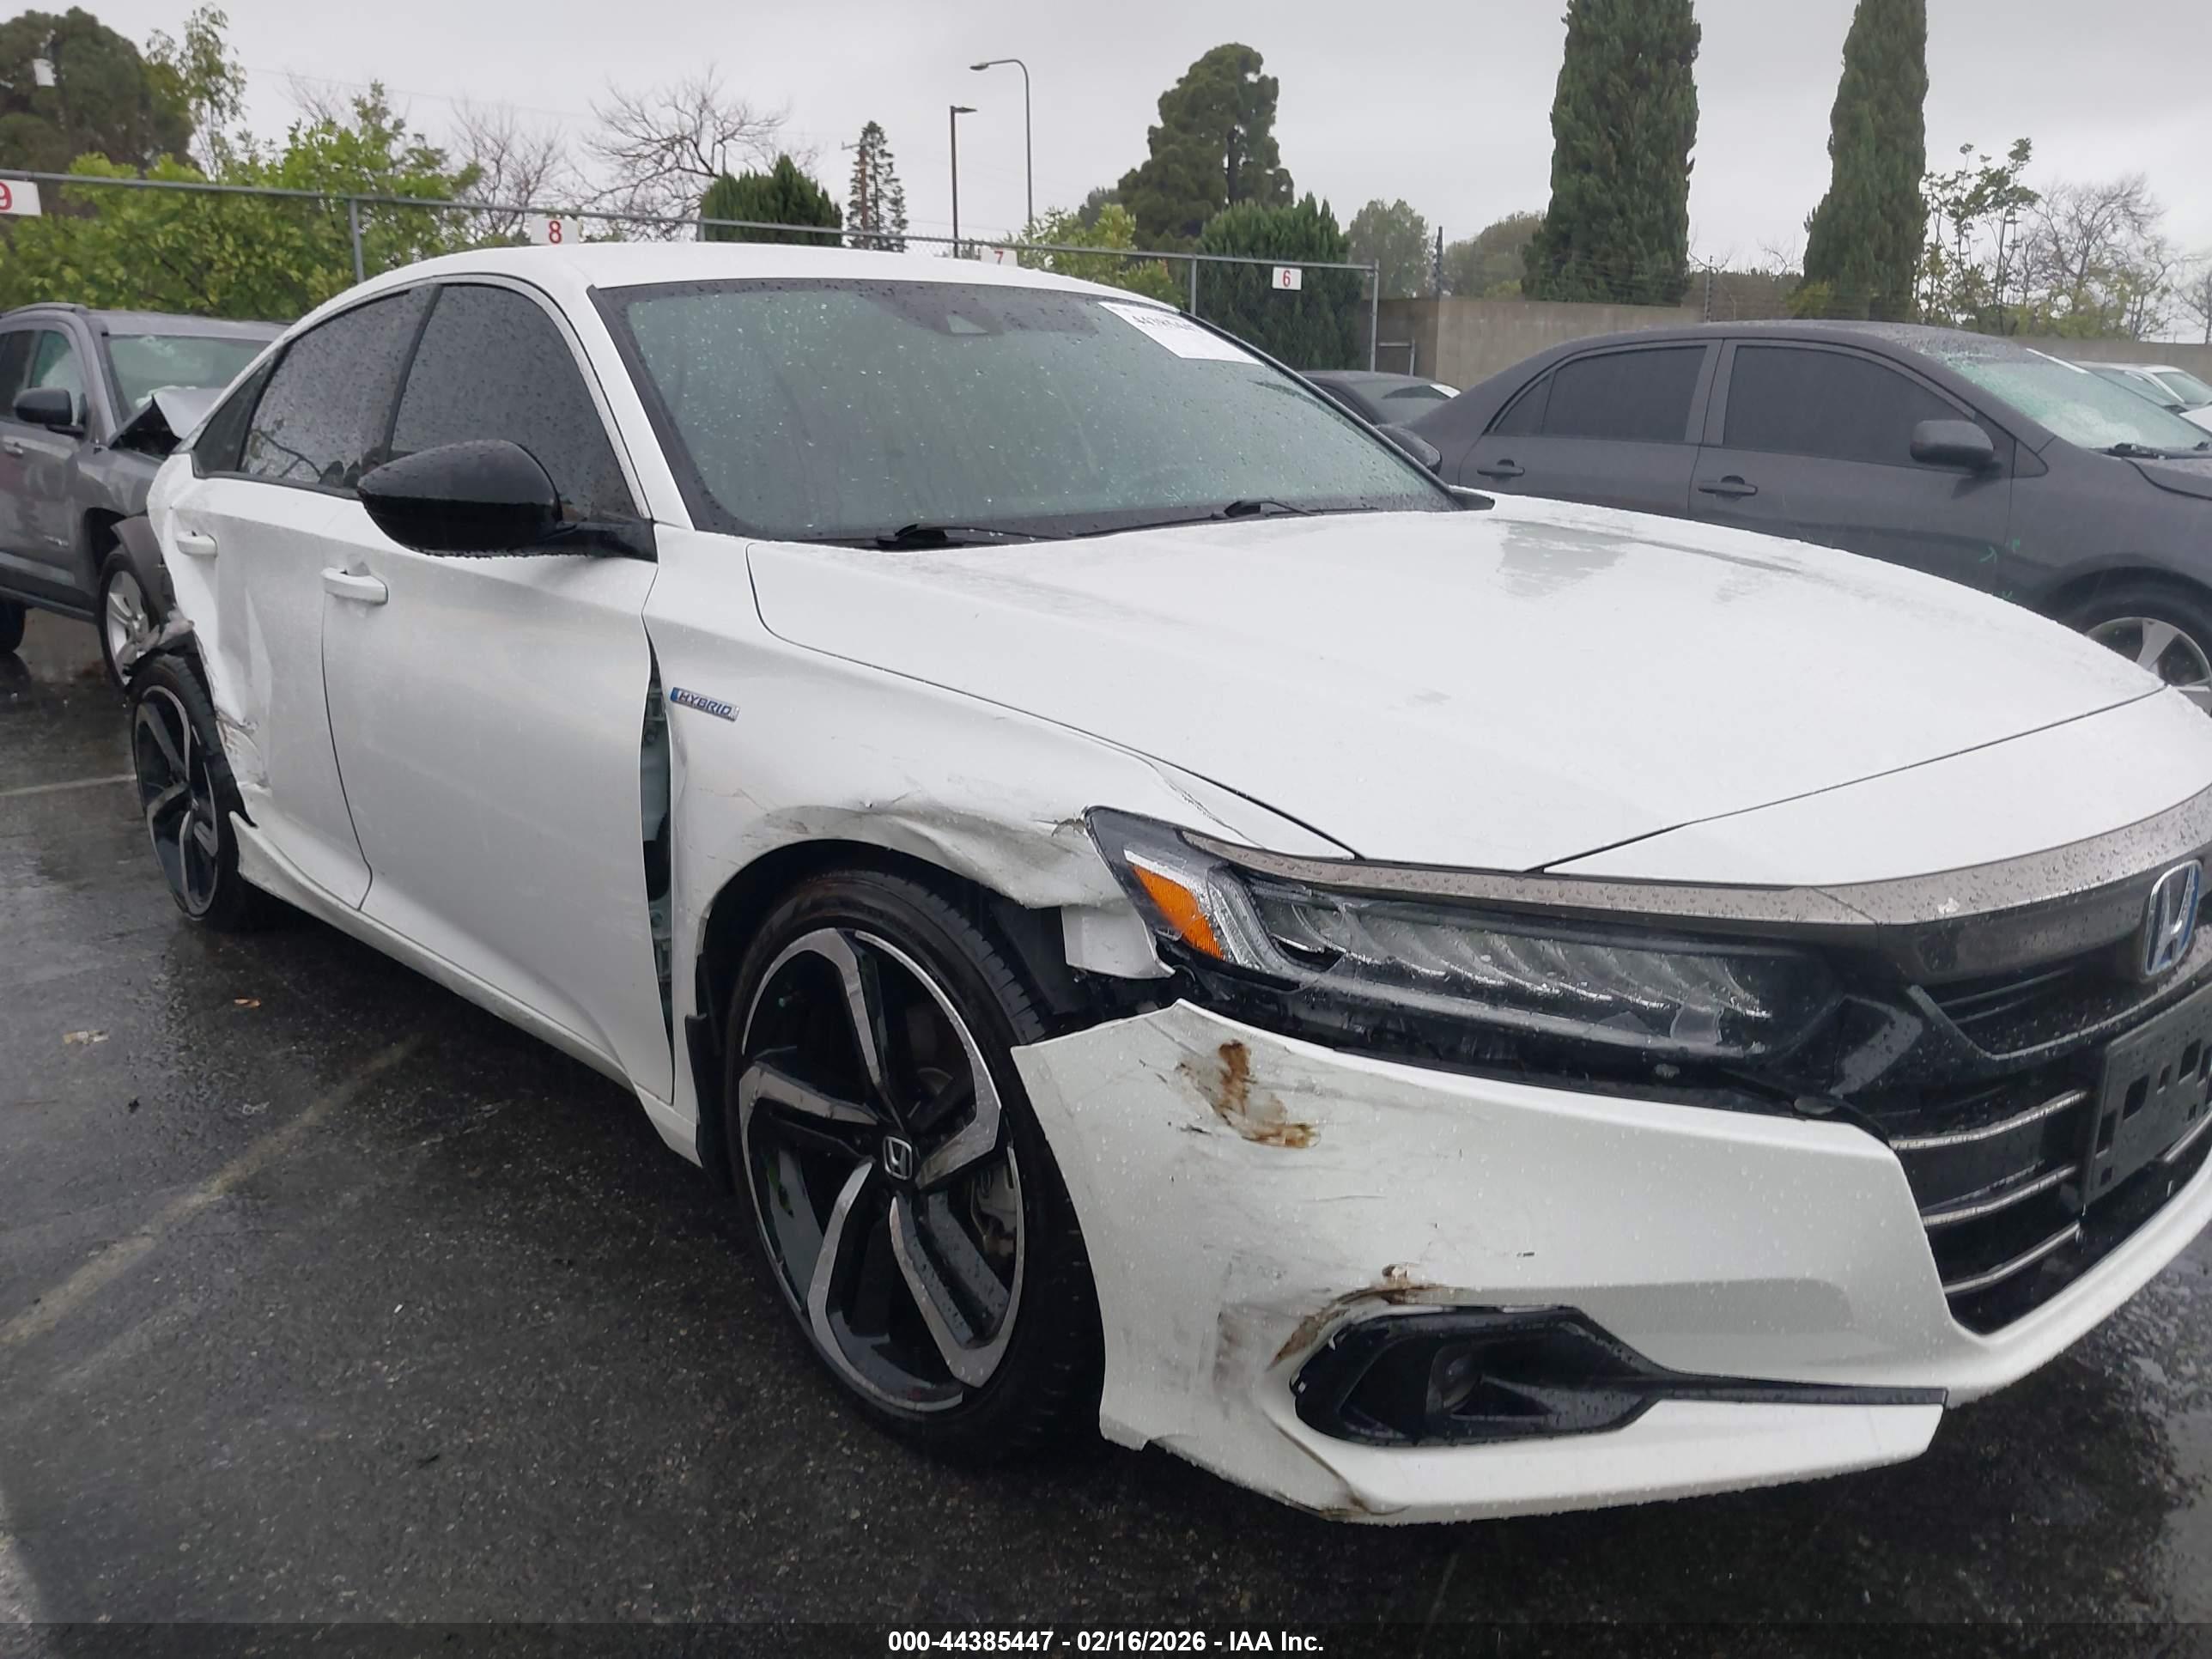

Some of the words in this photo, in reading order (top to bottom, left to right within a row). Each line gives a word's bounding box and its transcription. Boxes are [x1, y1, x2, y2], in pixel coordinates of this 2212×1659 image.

[549, 220, 562, 244] 8
[994, 251, 1003, 265] 7
[1283, 270, 1291, 288] 6
[678, 690, 732, 716] HYBRID
